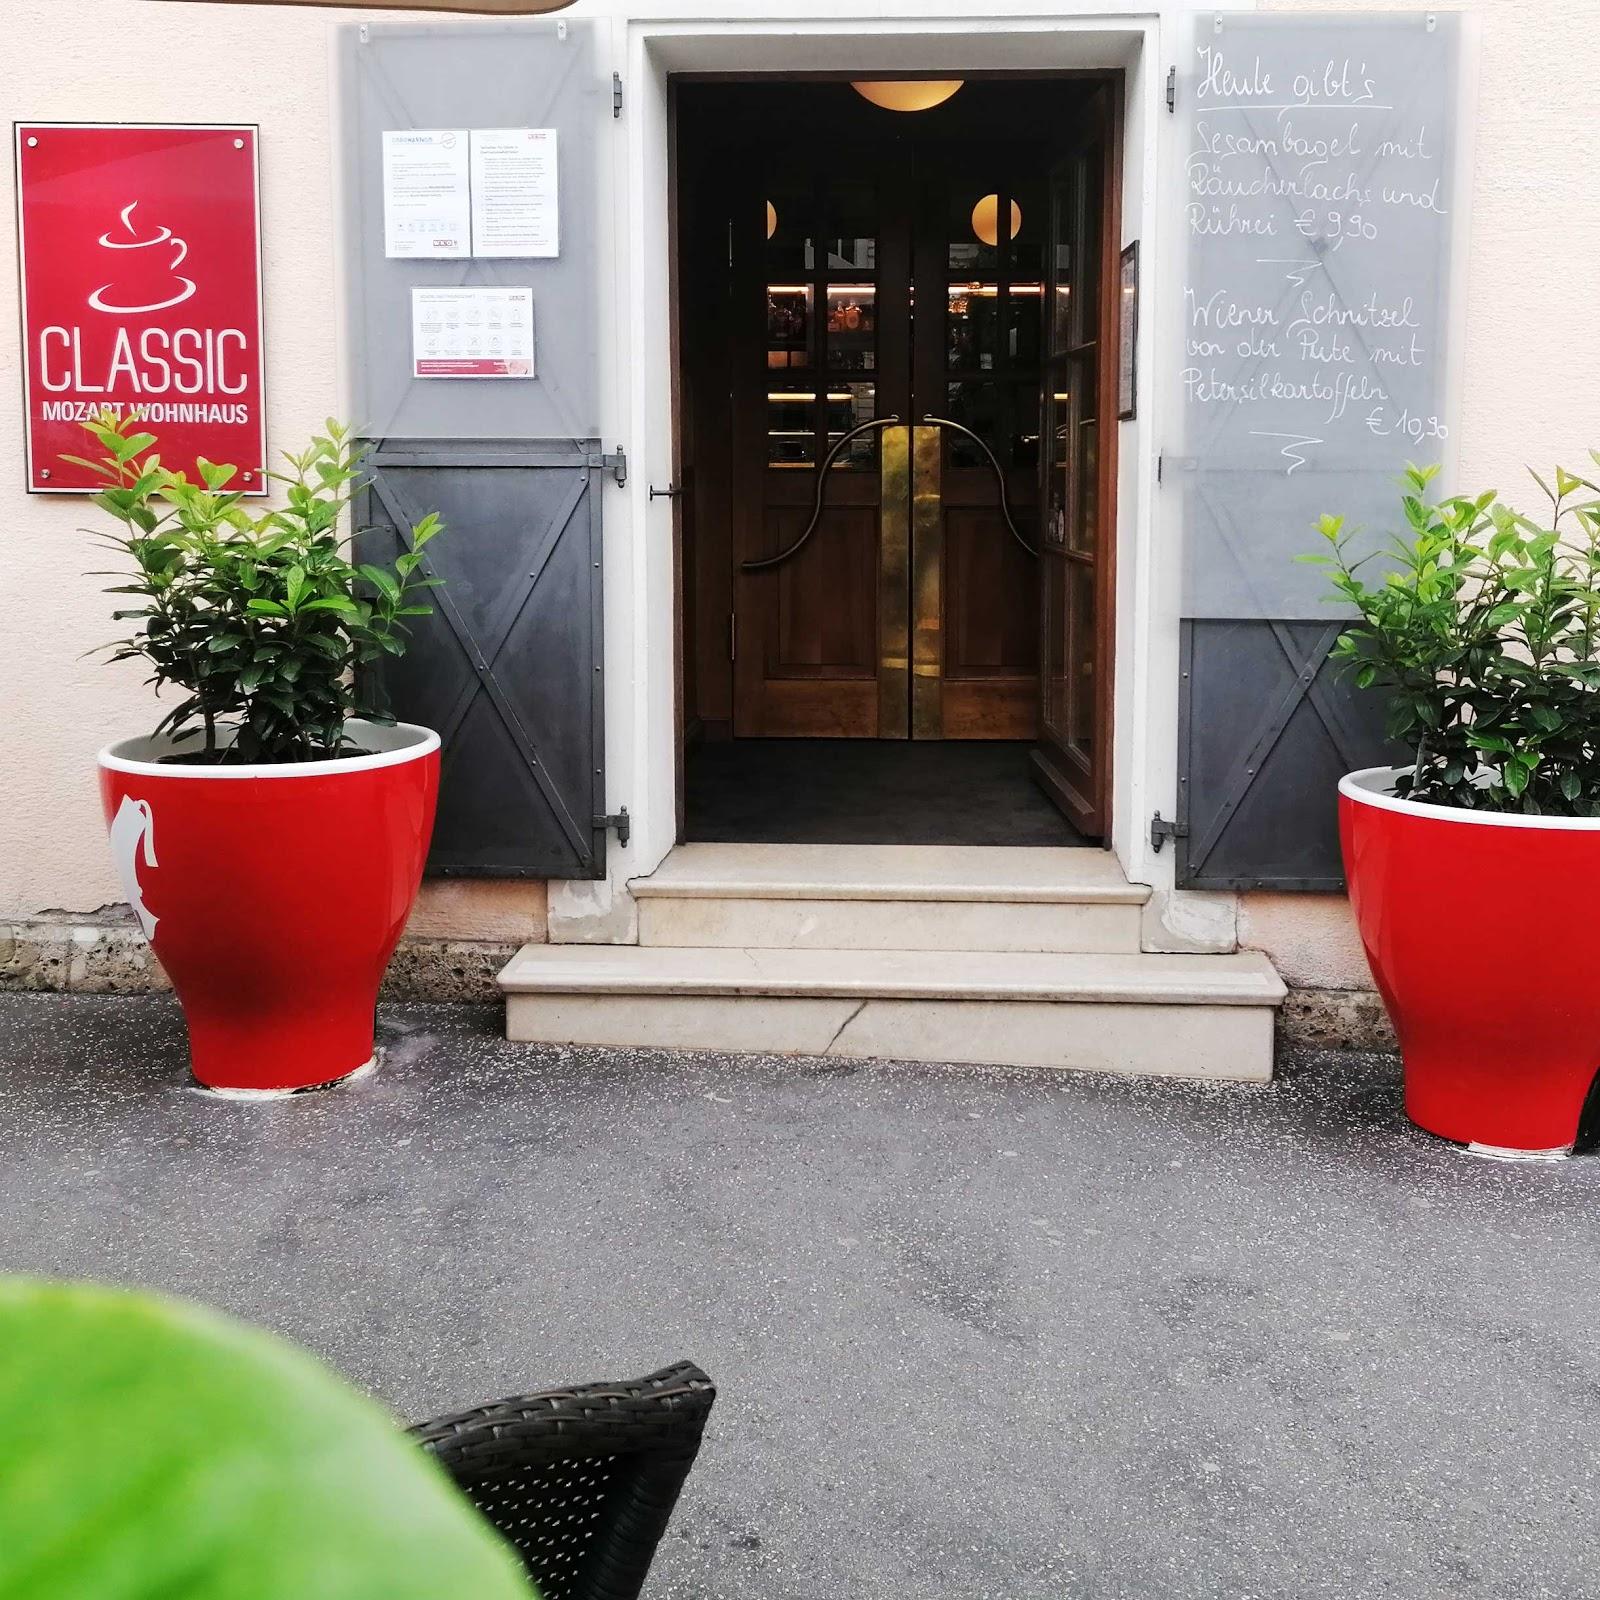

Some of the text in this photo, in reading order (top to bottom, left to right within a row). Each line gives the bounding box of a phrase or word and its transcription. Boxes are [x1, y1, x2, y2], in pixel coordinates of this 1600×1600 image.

[1196, 45, 1376, 122] Heute gibt's
[1185, 121, 1433, 176] Sesambagel mit
[1187, 162, 1449, 214] Räucherlachs und
[1184, 201, 1278, 236] Rührei
[1184, 285, 1421, 338] Wiener Schnitzel
[40, 325, 248, 395] CLASSIC
[1186, 327, 1426, 365] von der Pute mit
[130, 402, 249, 425] WOHNHAUS
[1179, 367, 1389, 425] Petersilkartoffeln
